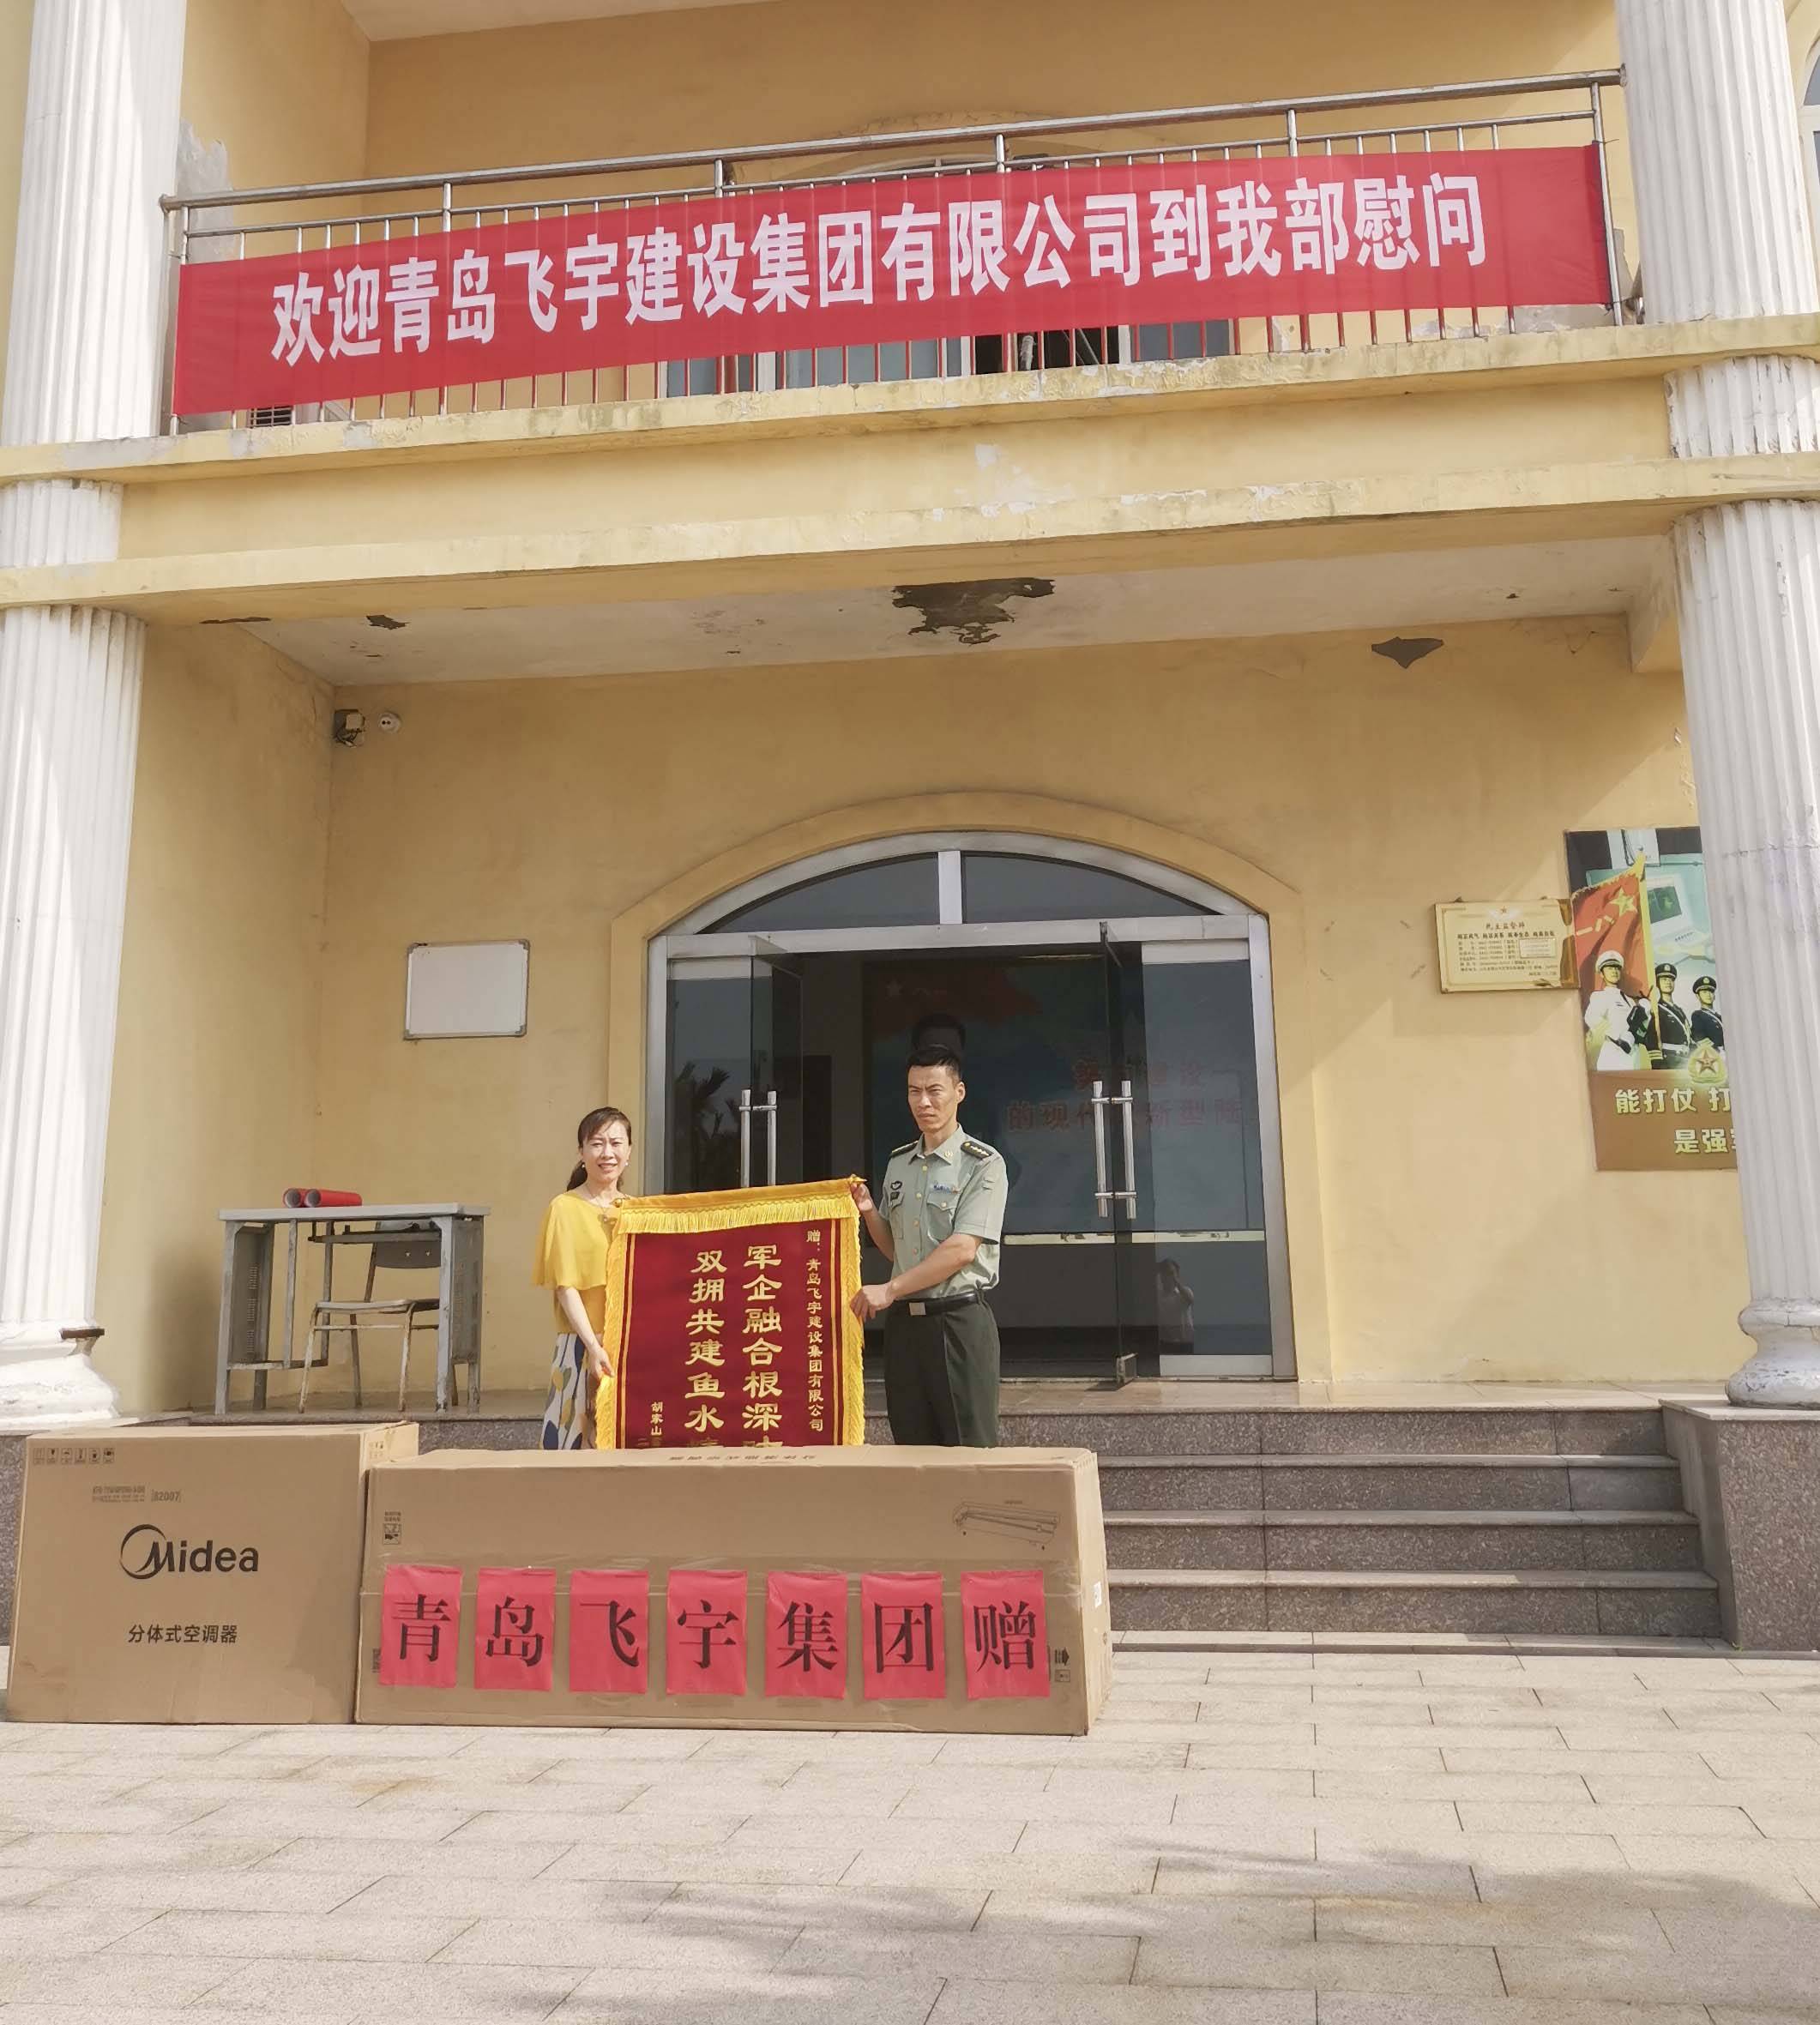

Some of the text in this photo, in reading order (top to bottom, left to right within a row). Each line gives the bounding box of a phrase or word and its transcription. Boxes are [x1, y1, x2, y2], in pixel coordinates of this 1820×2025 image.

[270, 172, 1487, 367] 欢迎青岛飞宇建设集团有限公司到我部慰问
[1615, 1088, 1731, 1113] 能打仗 打
[1674, 1128, 1736, 1154] 是强
[684, 1251, 727, 1446] 双拥共建鱼水
[120, 1524, 259, 1580] Midea
[128, 1624, 238, 1644] 分体式空调器
[392, 1594, 1036, 1672] 青岛飞宇集团赠
